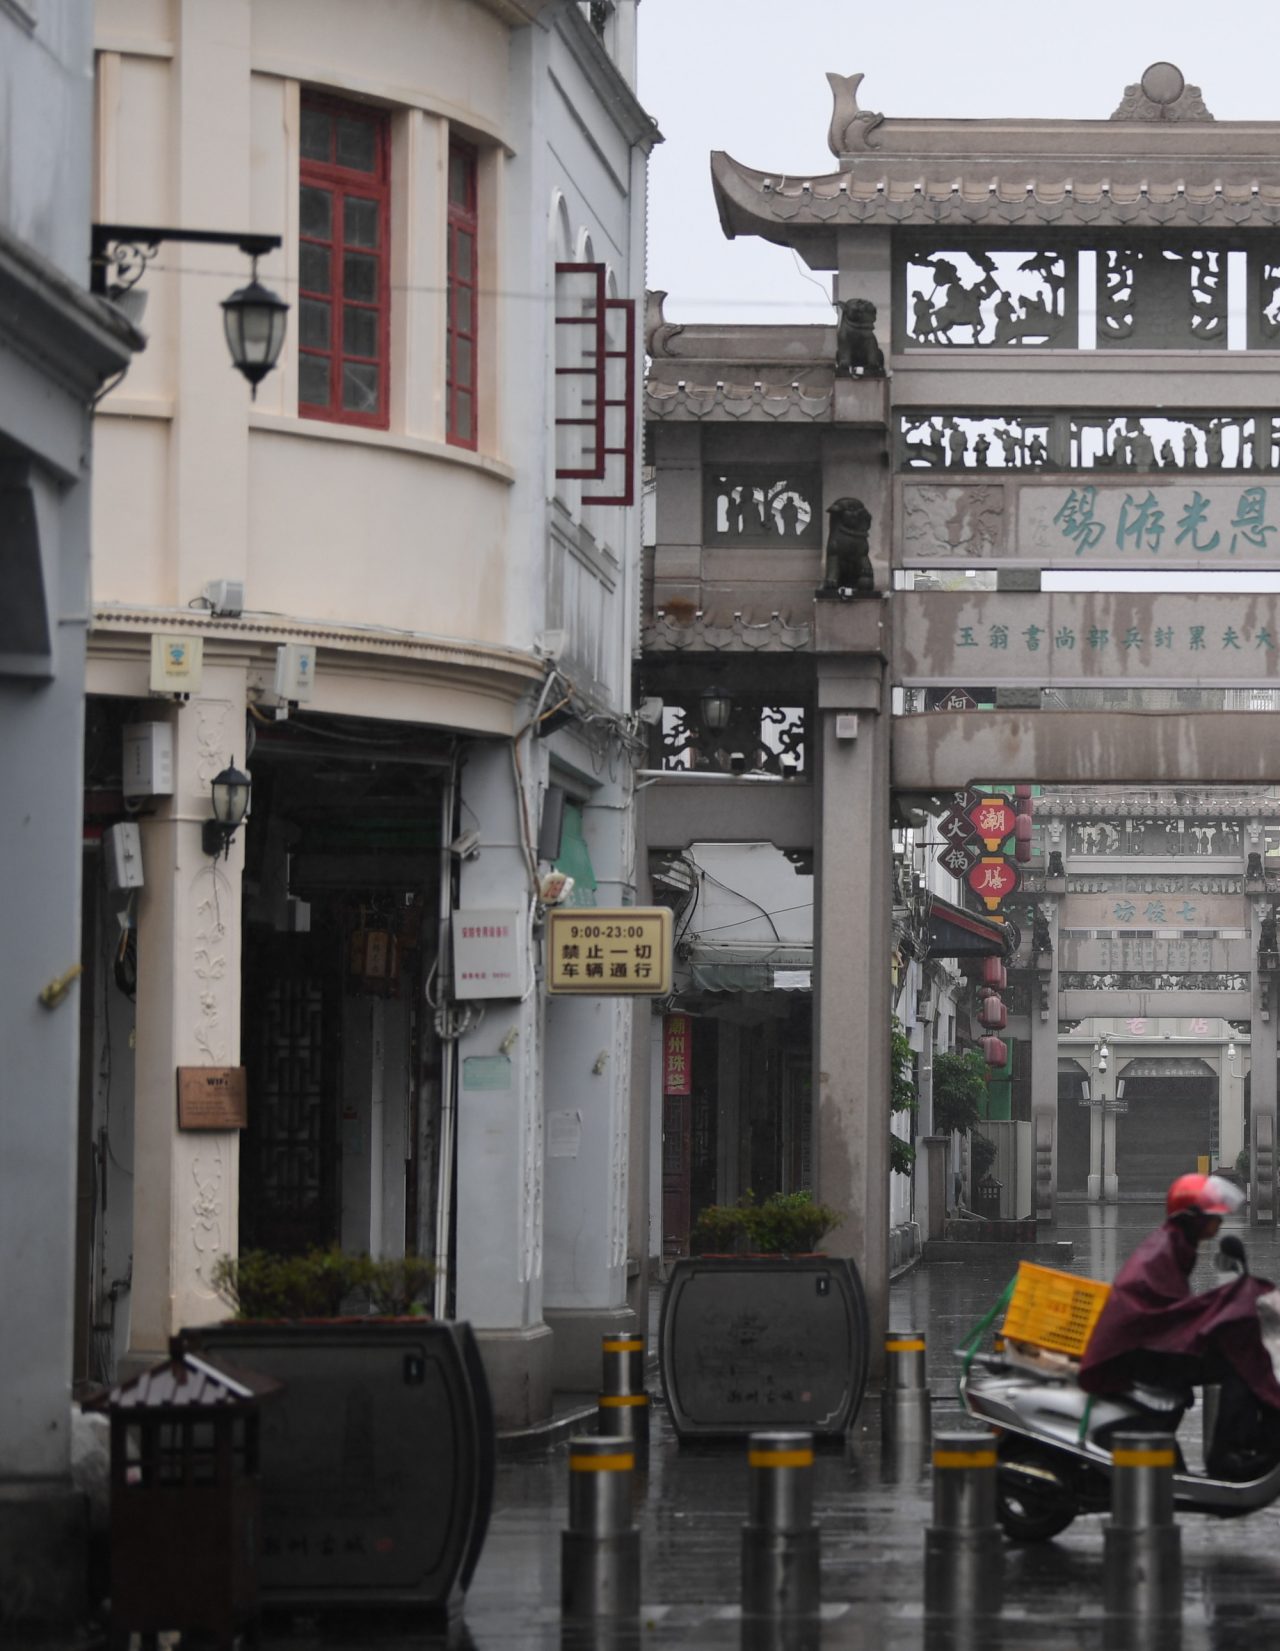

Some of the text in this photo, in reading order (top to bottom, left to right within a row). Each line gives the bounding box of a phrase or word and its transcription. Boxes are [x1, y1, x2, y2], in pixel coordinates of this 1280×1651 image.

[571, 926, 643, 938] 9:00-23:00
[562, 945, 652, 959] 禁止一切
[562, 963, 652, 978] 车辆通行
